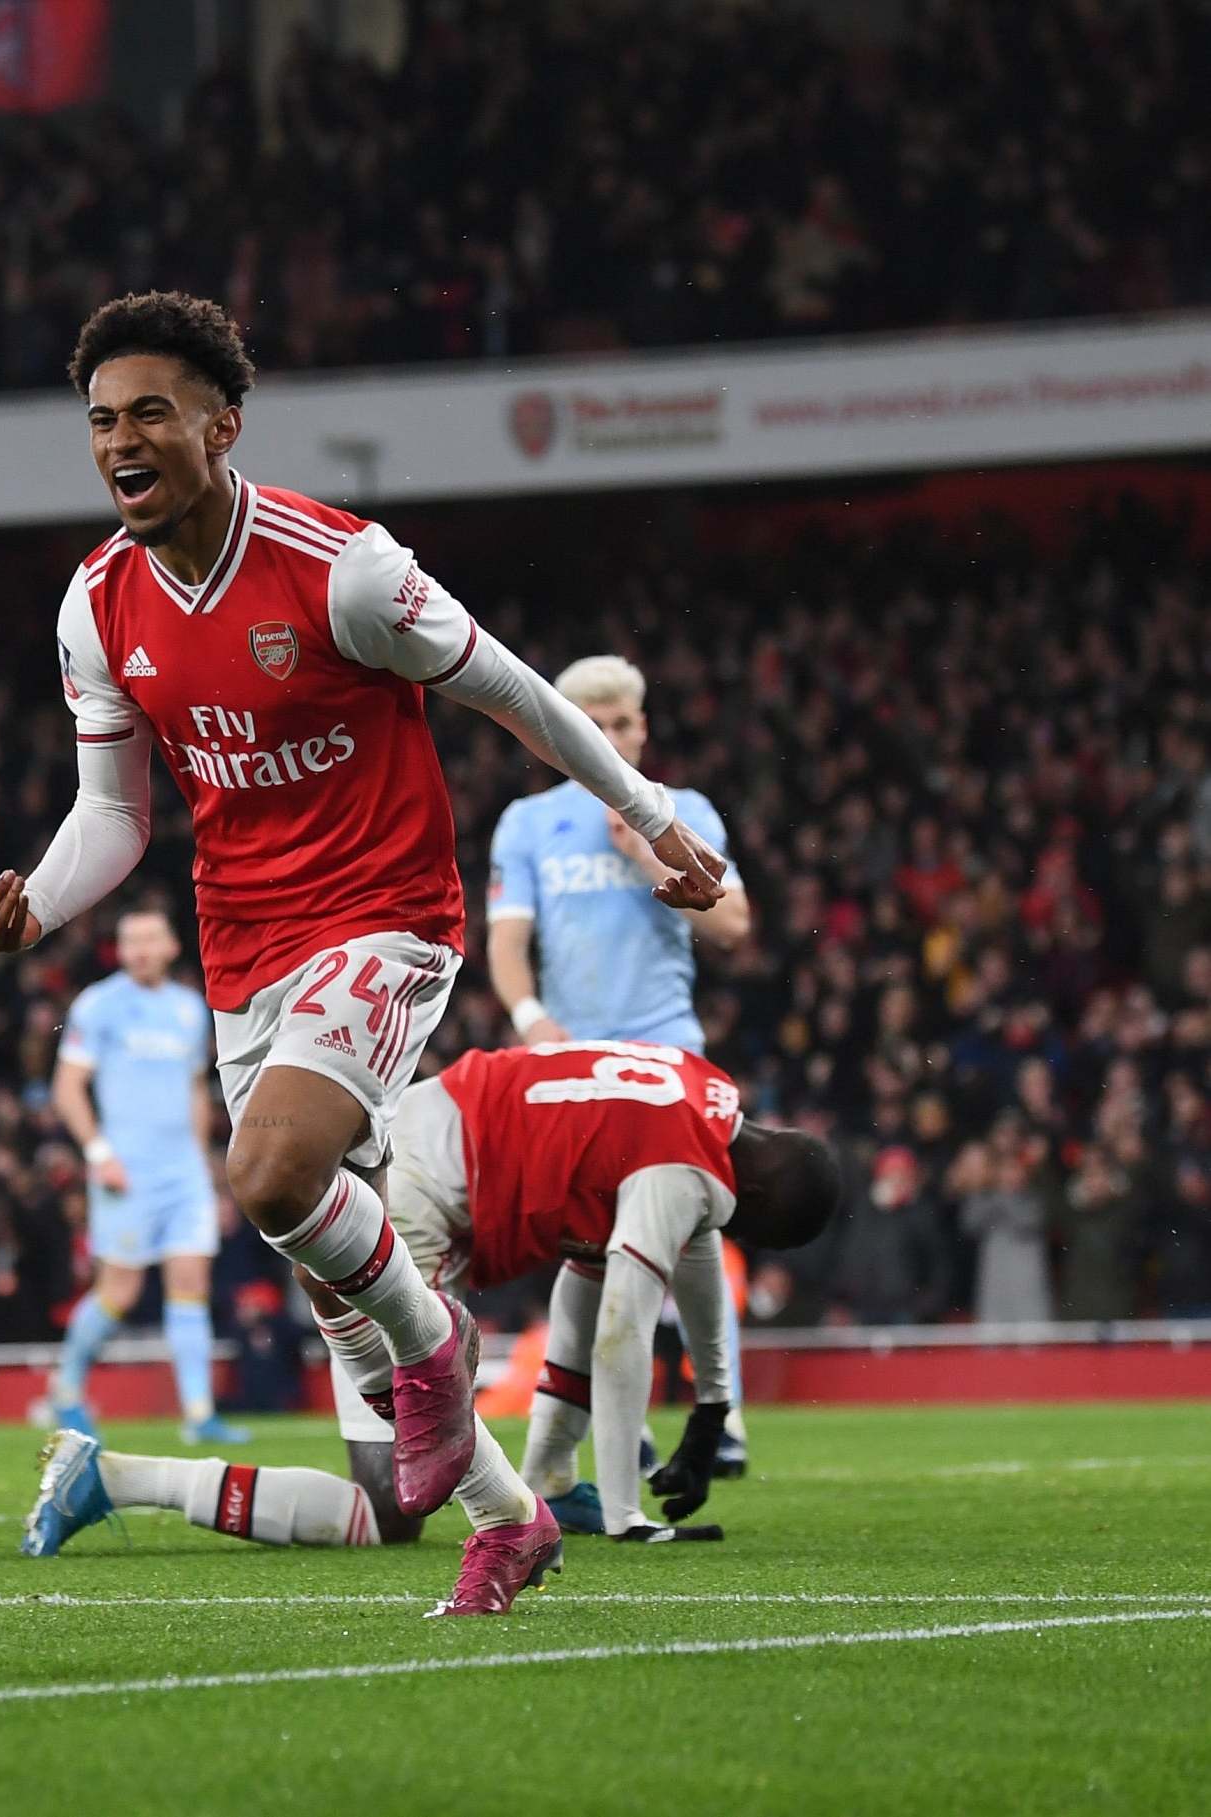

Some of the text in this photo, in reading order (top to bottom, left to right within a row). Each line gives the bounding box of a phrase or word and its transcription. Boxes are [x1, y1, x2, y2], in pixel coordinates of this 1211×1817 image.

[255, 629, 291, 644] Arsenal
[123, 664, 158, 677] adidas
[189, 705, 256, 744] Fly
[291, 950, 390, 1036] 24
[314, 1036, 358, 1058] adidas
